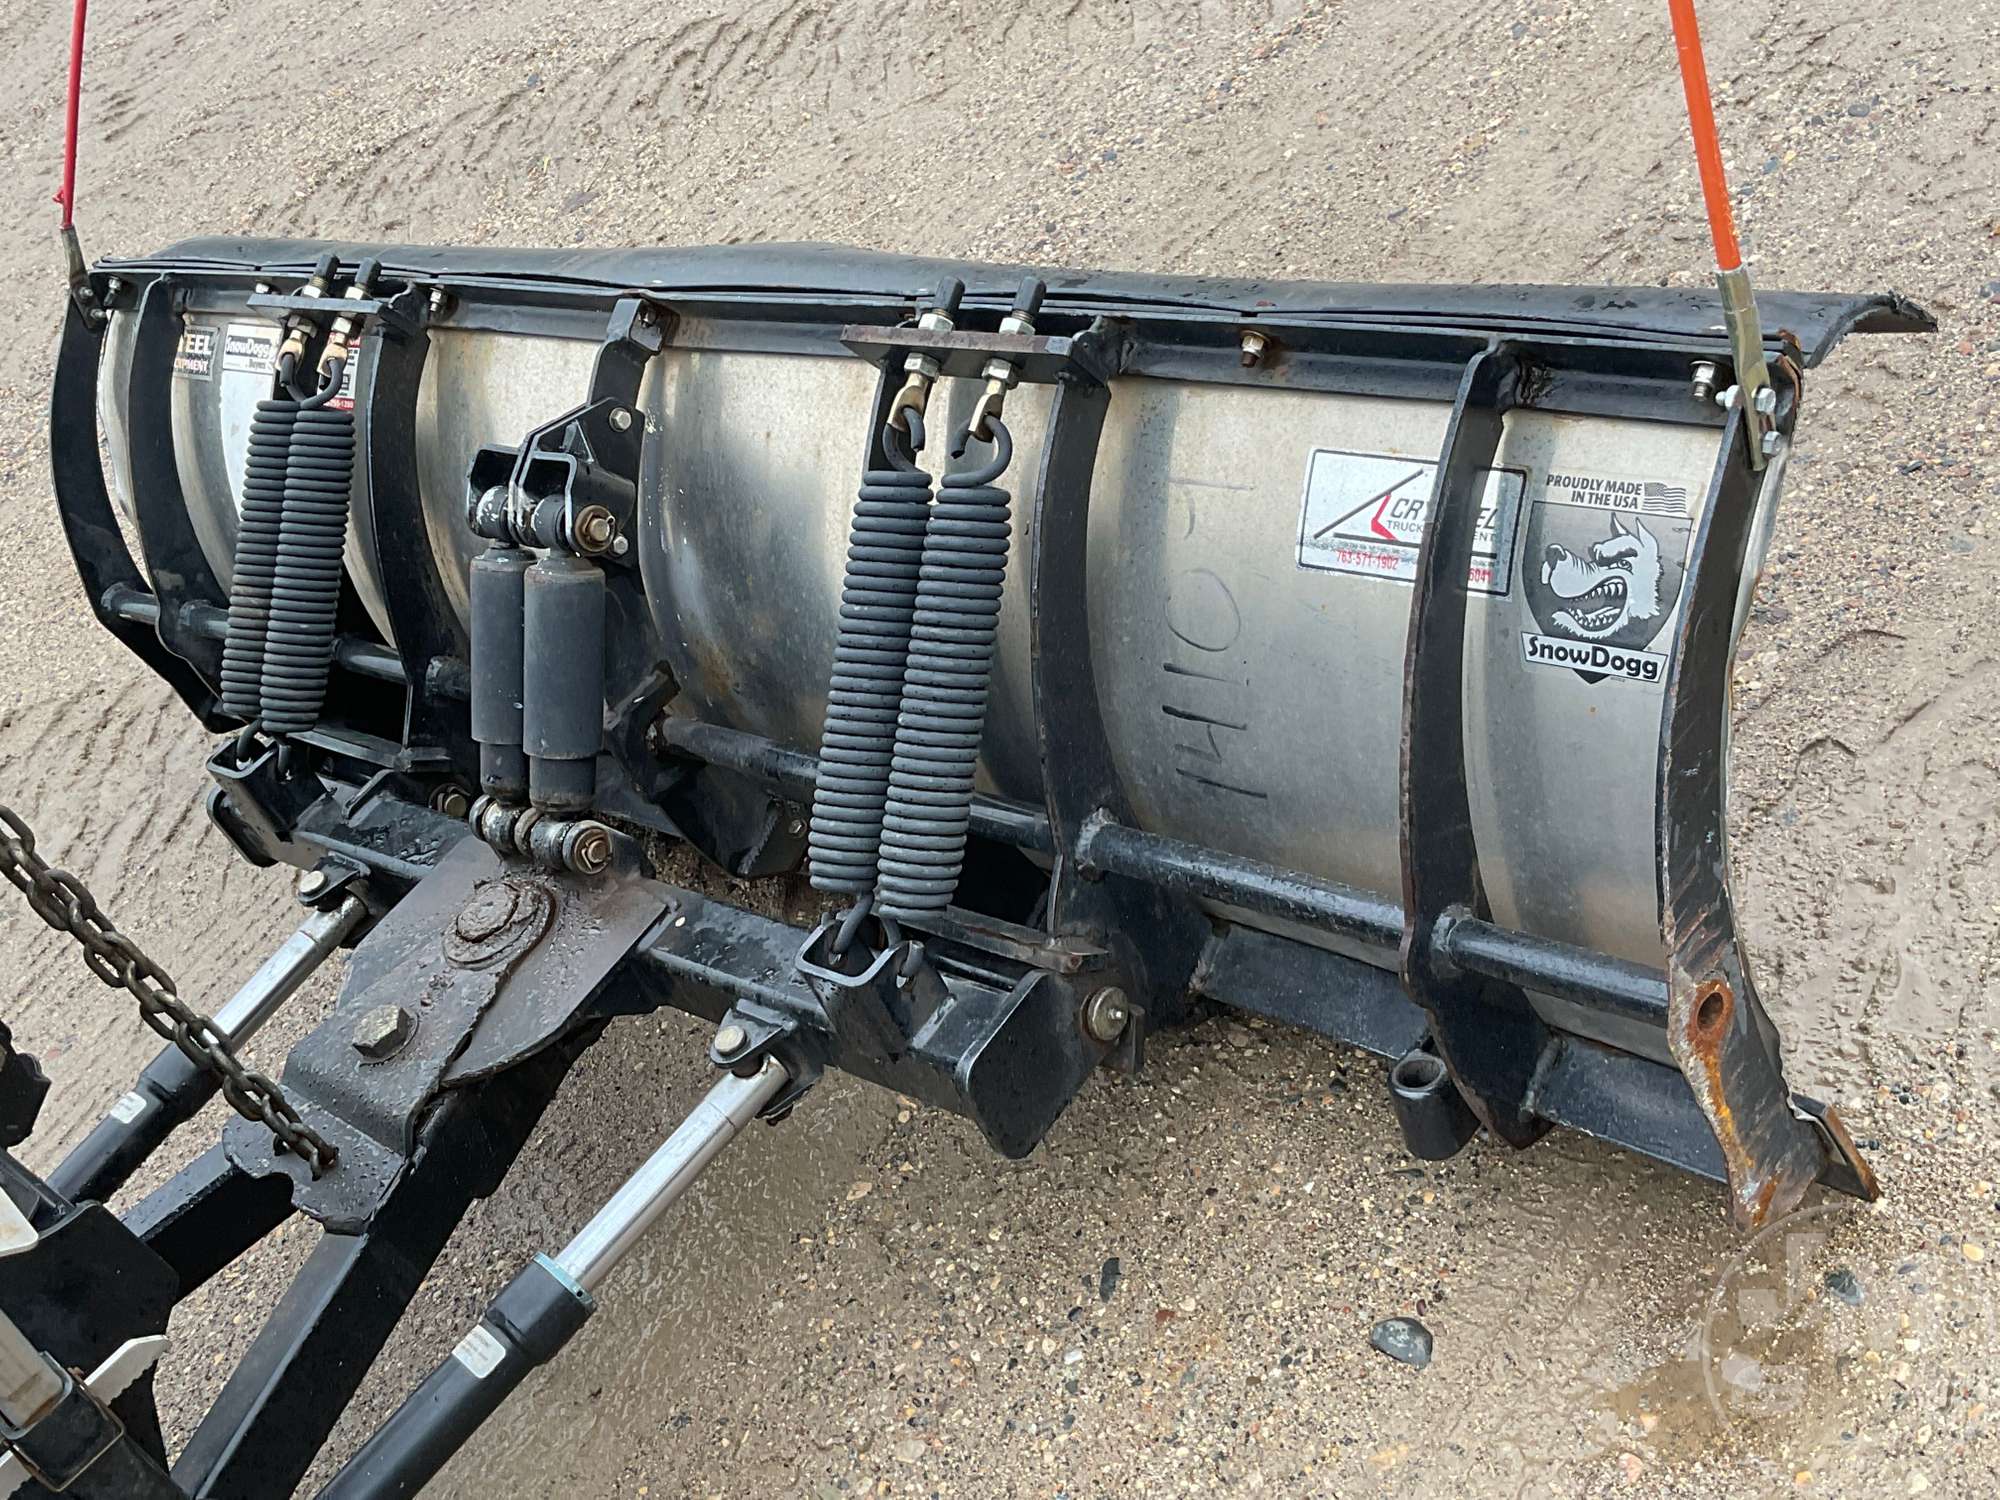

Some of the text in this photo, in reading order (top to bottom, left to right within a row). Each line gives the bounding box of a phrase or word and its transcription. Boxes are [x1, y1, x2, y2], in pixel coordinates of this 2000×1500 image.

[1546, 475, 1643, 495] PROUDLY MADE
[1571, 490, 1639, 509] IN THE USA
[1387, 519, 1424, 533] TRUCK
[1336, 549, 1400, 571] 763-571-1902
[1528, 636, 1659, 680] SnowDogg
